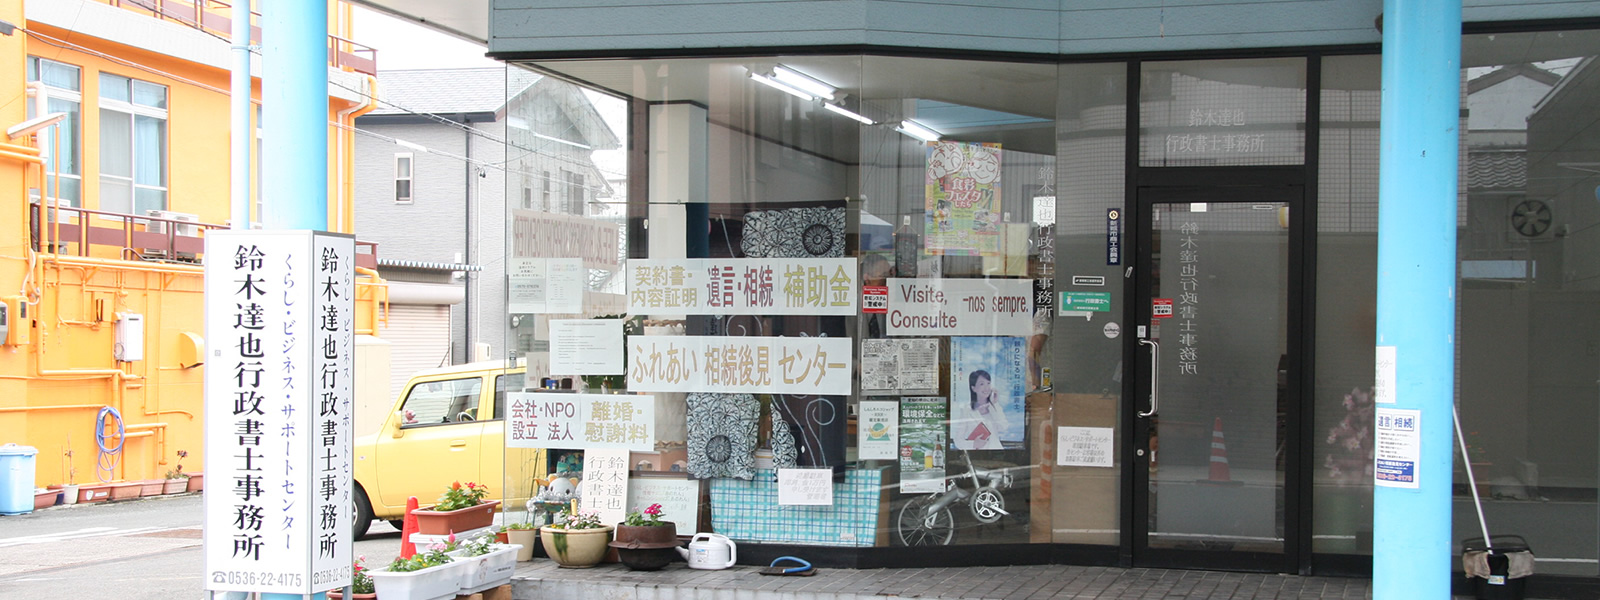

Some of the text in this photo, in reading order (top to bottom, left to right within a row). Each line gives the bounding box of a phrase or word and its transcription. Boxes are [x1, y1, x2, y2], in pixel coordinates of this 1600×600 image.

[1188, 108, 1246, 128] 鈴木達也
[1165, 133, 1266, 153] 行政書士事務所
[945, 190, 982, 203] フェスタ
[1036, 166, 1055, 318] 鈴木達也行政書士事務所
[635, 265, 694, 287] 契約書・
[706, 265, 774, 308] 遺言・相続
[783, 264, 852, 308] 補助金
[631, 288, 698, 308] 内容証明
[900, 284, 948, 304] Visite,
[992, 293, 1030, 319] sempre.
[890, 307, 957, 329] Consulte
[632, 343, 698, 385] ふれあい
[704, 345, 772, 387] 相続後見
[778, 344, 847, 387] センター
[342, 255, 352, 519] くらし・ビジネス・サポートセンター
[232, 244, 267, 562] 鈴木達也行政書士事務所
[281, 253, 297, 550] くらし・ビジネス・サポートセンター
[319, 246, 339, 561] 鈴木達也行政書士事務所
[511, 399, 576, 419] 会社・NPO
[591, 400, 643, 421] 離婚・
[512, 421, 575, 441] 設立 法人
[585, 422, 649, 444] 慰謝料
[1394, 417, 1413, 429] 相続
[587, 456, 605, 519] 行政書士
[606, 456, 625, 511] 鈴木達也
[227, 570, 303, 588] 0536-22-4175
[319, 565, 351, 586] 0536-22-4175
